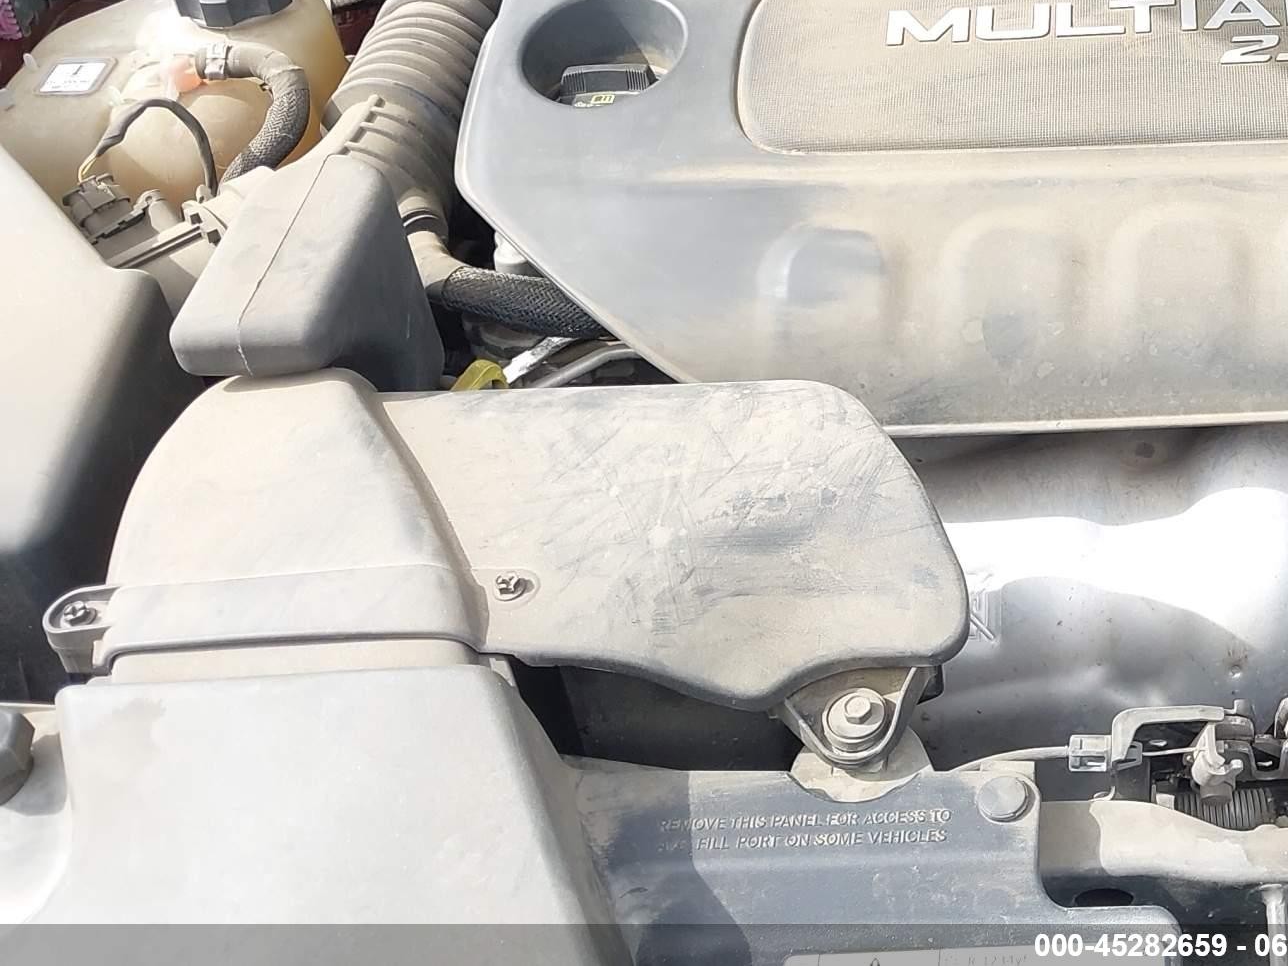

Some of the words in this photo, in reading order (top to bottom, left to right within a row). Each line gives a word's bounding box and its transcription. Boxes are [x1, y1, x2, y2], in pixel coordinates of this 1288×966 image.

[660, 817, 727, 832] REMOVE
[730, 815, 767, 829] THIS
[770, 813, 823, 828] PANEL
[827, 812, 860, 826] FOR
[864, 810, 926, 824] ACCESS
[929, 808, 952, 822] TO
[696, 836, 730, 850] FILL
[736, 833, 782, 849] PORT
[785, 832, 810, 846] ON
[813, 831, 865, 846] SOME
[868, 829, 948, 844] VEHICLES
